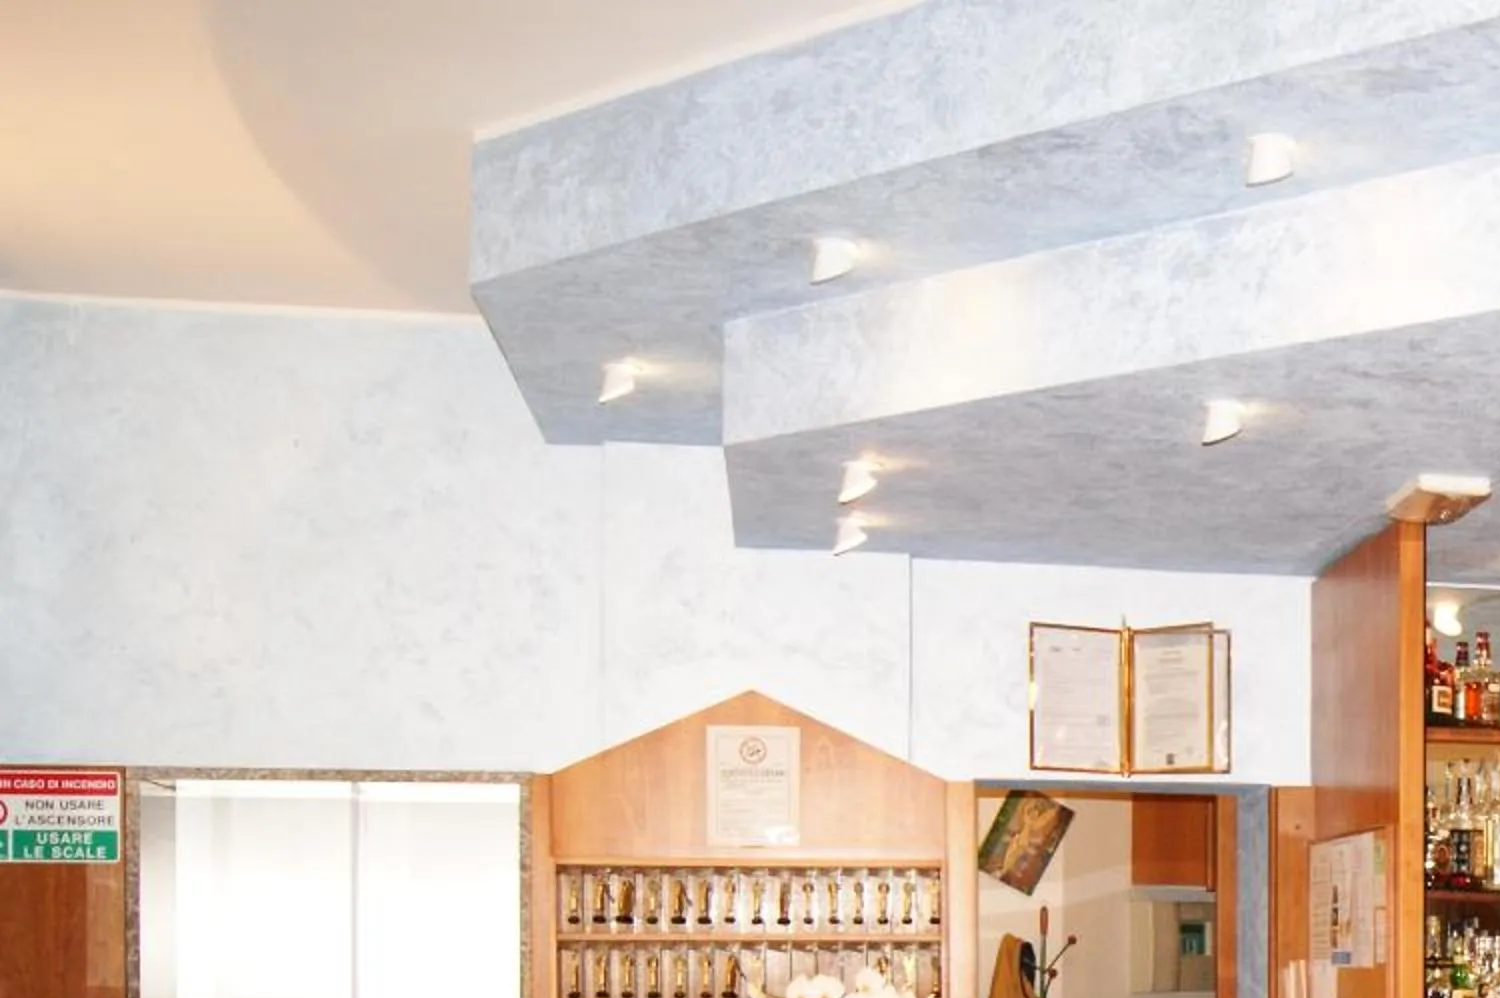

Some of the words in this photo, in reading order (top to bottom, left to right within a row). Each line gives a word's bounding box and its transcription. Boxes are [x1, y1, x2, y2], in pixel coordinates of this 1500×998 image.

[25, 800, 55, 811] NON
[59, 800, 105, 811] USARE
[15, 815, 115, 826] L'ASCENSORE
[36, 832, 94, 845] USARE
[23, 846, 45, 859] LE
[51, 846, 108, 859] SCALE
